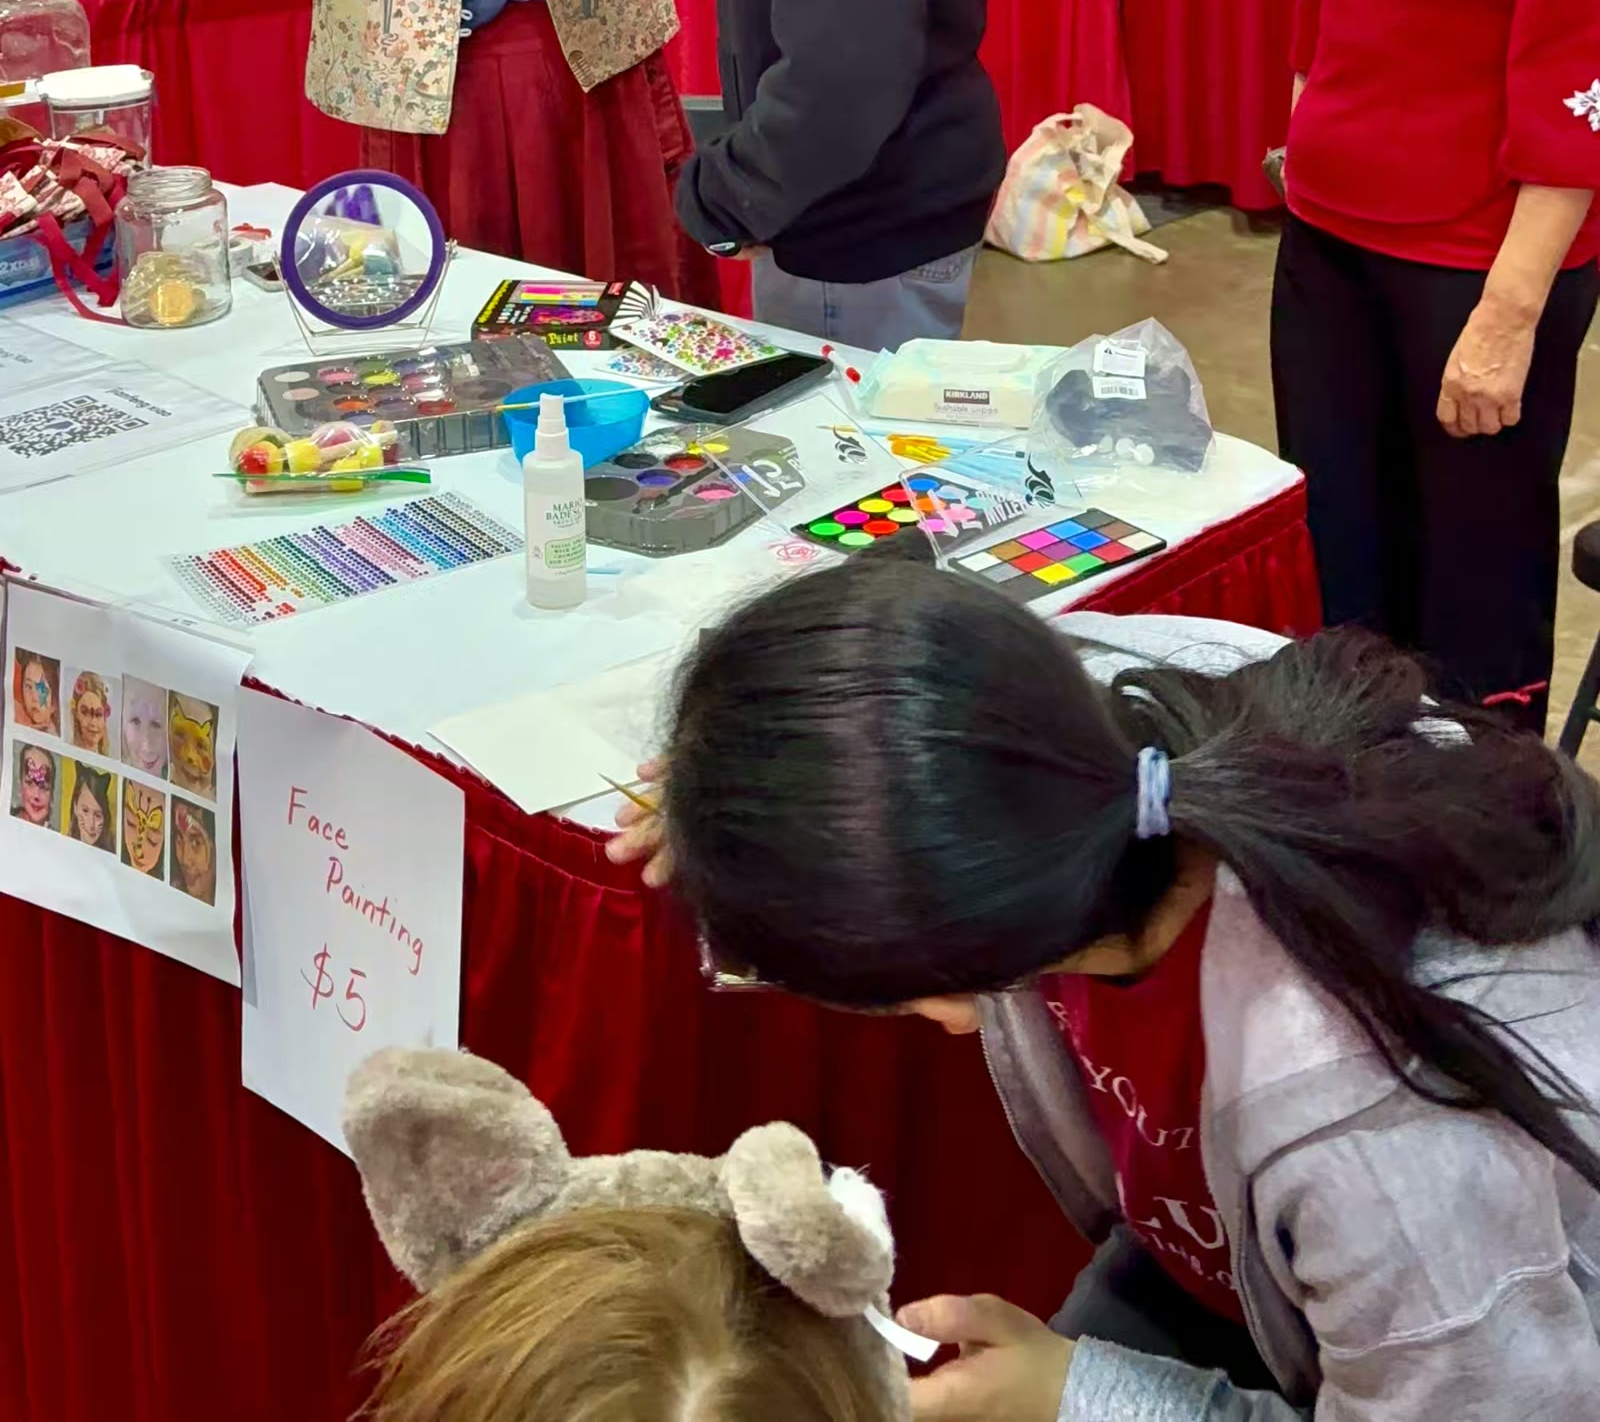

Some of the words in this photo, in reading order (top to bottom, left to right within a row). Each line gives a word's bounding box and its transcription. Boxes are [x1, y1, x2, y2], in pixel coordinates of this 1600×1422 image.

[945, 390, 988, 400] KIRKLAND
[288, 786, 349, 850] Face
[326, 856, 424, 976] Painting
[300, 942, 367, 1032] $5
